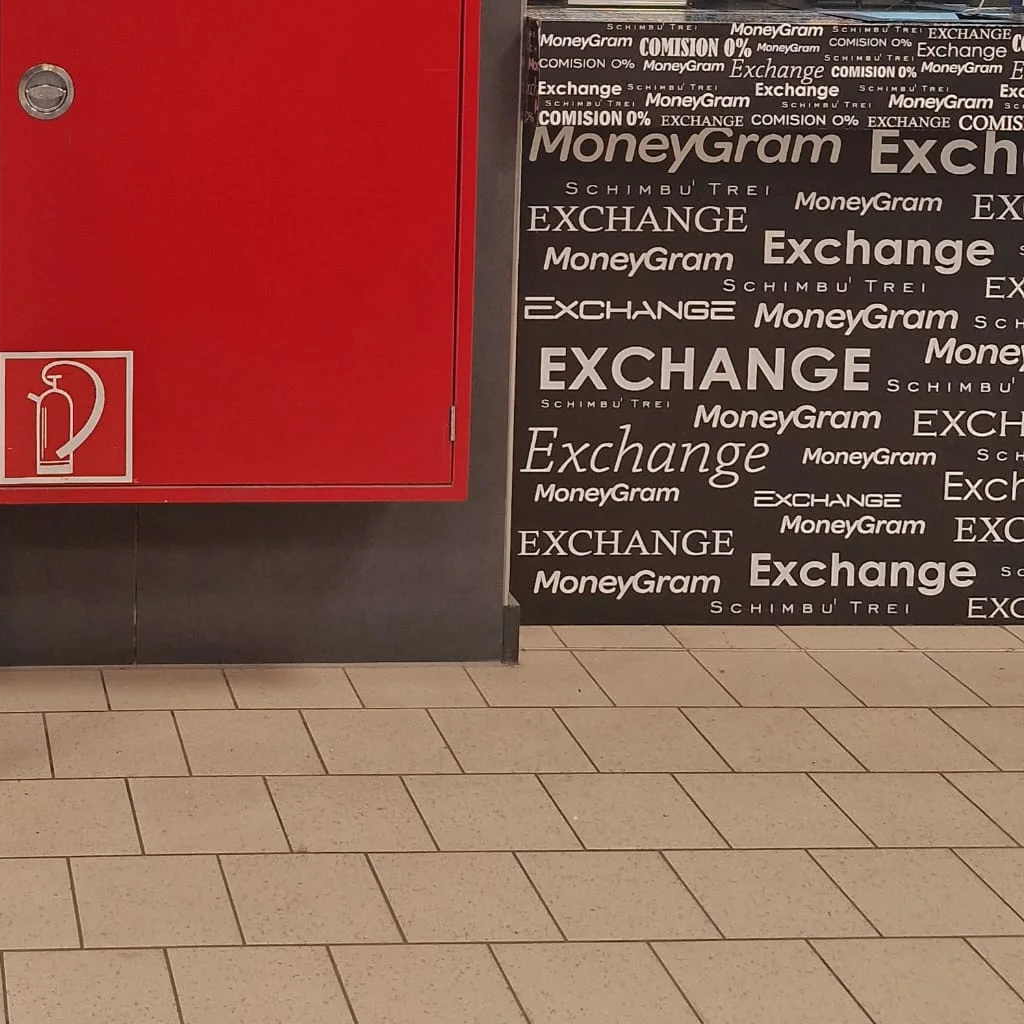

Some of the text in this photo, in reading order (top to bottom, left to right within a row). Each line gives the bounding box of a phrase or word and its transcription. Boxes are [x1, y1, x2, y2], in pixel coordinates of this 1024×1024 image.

[730, 23, 823, 40] MoneyGram
[928, 28, 1012, 40] EXCHANGE
[540, 34, 633, 50] MoneyGram
[639, 37, 752, 57] COMISION 0%
[757, 43, 820, 56] MoneyGram
[829, 38, 912, 48] COMISION 0%
[917, 42, 1007, 61] Exchange
[539, 58, 635, 69] COMISION 0%
[643, 59, 725, 74] MoneyGram
[728, 58, 824, 84] Exchange
[831, 66, 917, 79] COMISION 0%
[921, 61, 1003, 76] MoneyGram
[538, 81, 622, 98] Exchange
[755, 83, 839, 100] Exchange
[645, 93, 750, 111] MoneyGram
[888, 94, 993, 112] MoneyGram
[538, 110, 651, 126] COMISION 0%
[661, 115, 744, 127] EXCHANGE
[751, 114, 859, 126] COMISION 0%
[867, 116, 951, 128] EXCHANGE
[528, 126, 842, 174] MoneyGram
[794, 192, 943, 216] MoneyGram
[527, 205, 748, 233] EXCHANGE
[543, 246, 734, 278] MoneyGram
[763, 230, 995, 275] Exchange
[524, 296, 736, 320] EXCHANGE
[754, 302, 959, 336] MoneyGram
[925, 337, 1024, 373] Mone
[539, 346, 872, 392] EXCHANGE
[693, 404, 882, 435] MoneyGram
[519, 424, 770, 489] Exchange
[802, 447, 937, 470] MoneyGram
[534, 483, 680, 507] MoneyGram
[753, 490, 902, 508] EXCHANGE
[780, 515, 926, 540] MoneyGram
[517, 529, 735, 556] EXCHANGE
[750, 552, 977, 596] Exchange
[533, 569, 721, 601] MoneyGram
